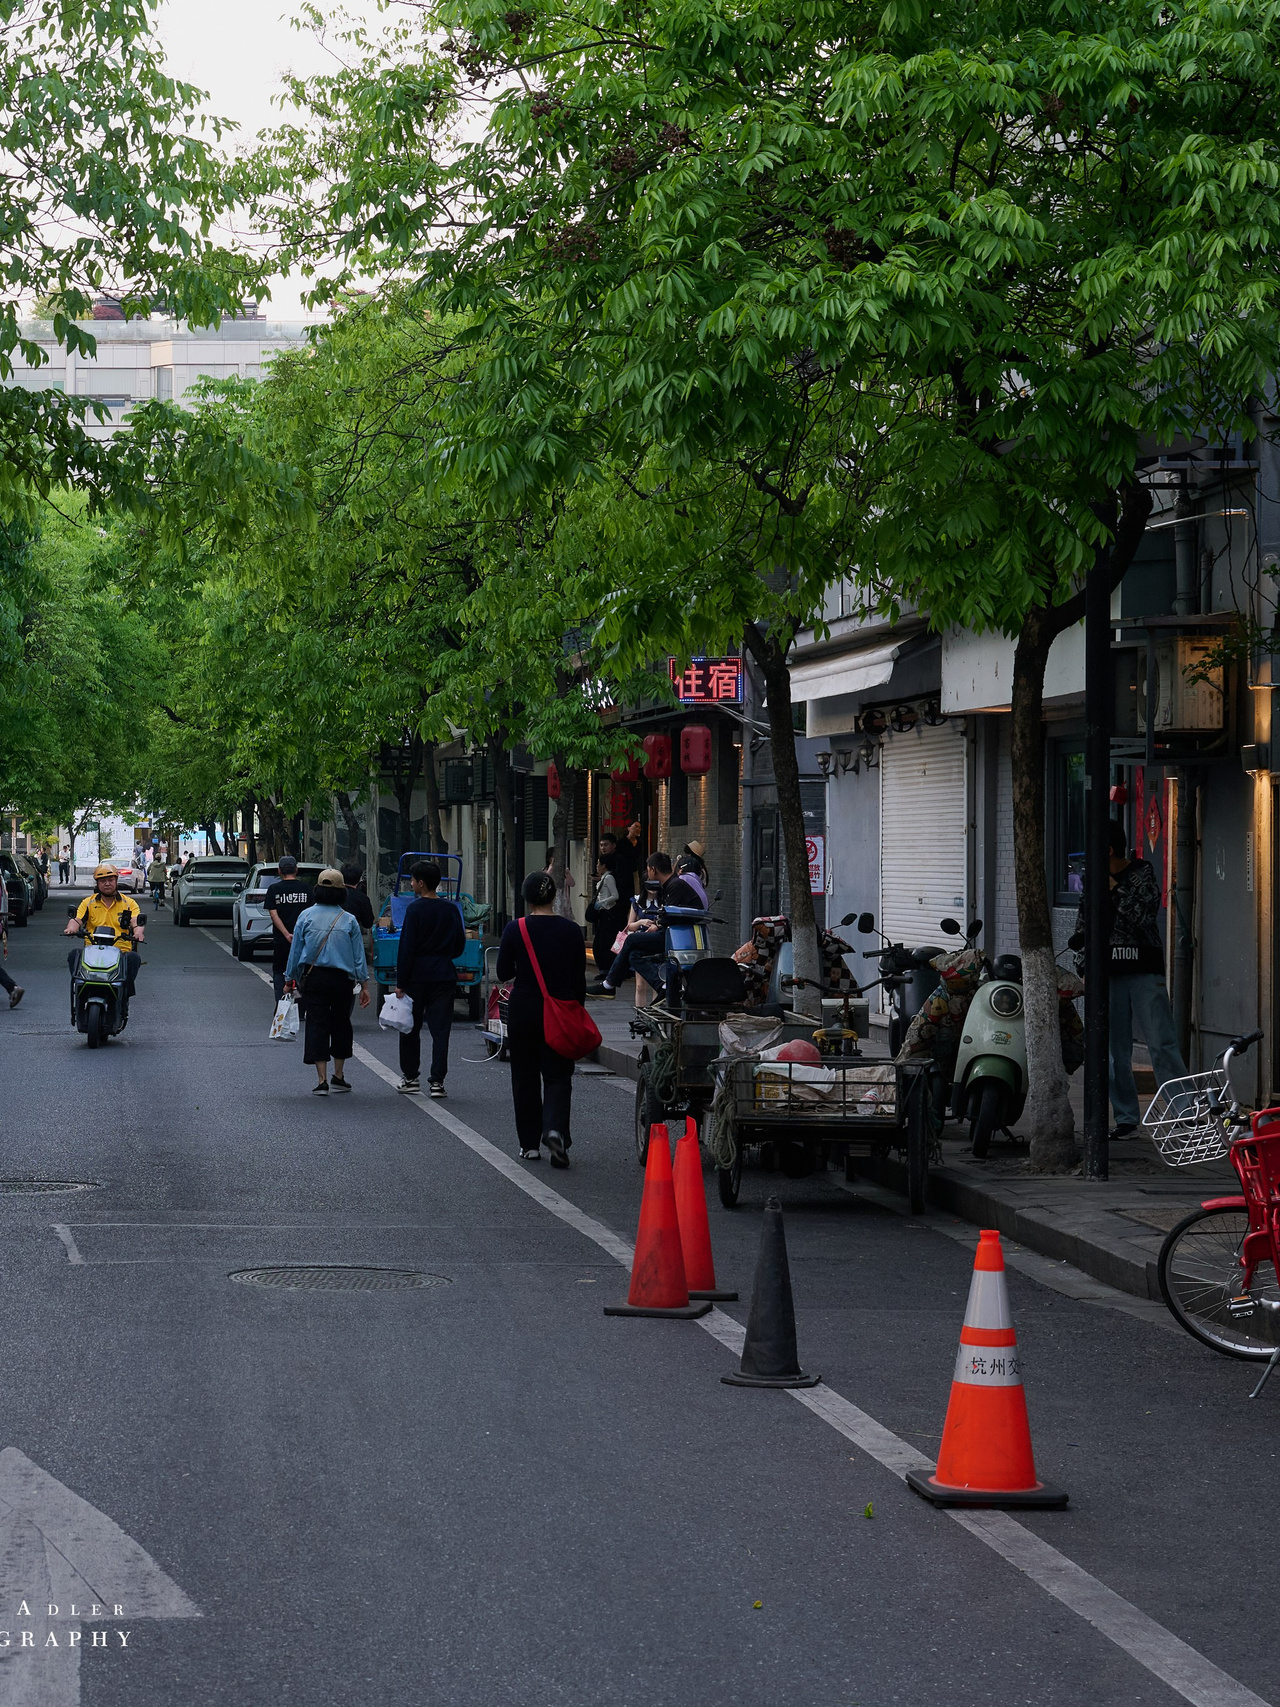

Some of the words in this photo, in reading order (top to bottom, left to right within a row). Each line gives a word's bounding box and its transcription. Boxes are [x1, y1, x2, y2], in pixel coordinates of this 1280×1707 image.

[674, 662, 739, 699] 住宿
[280, 892, 308, 904] 小吃街
[1111, 947, 1139, 960] ATION
[970, 1356, 1020, 1376] 杭州交
